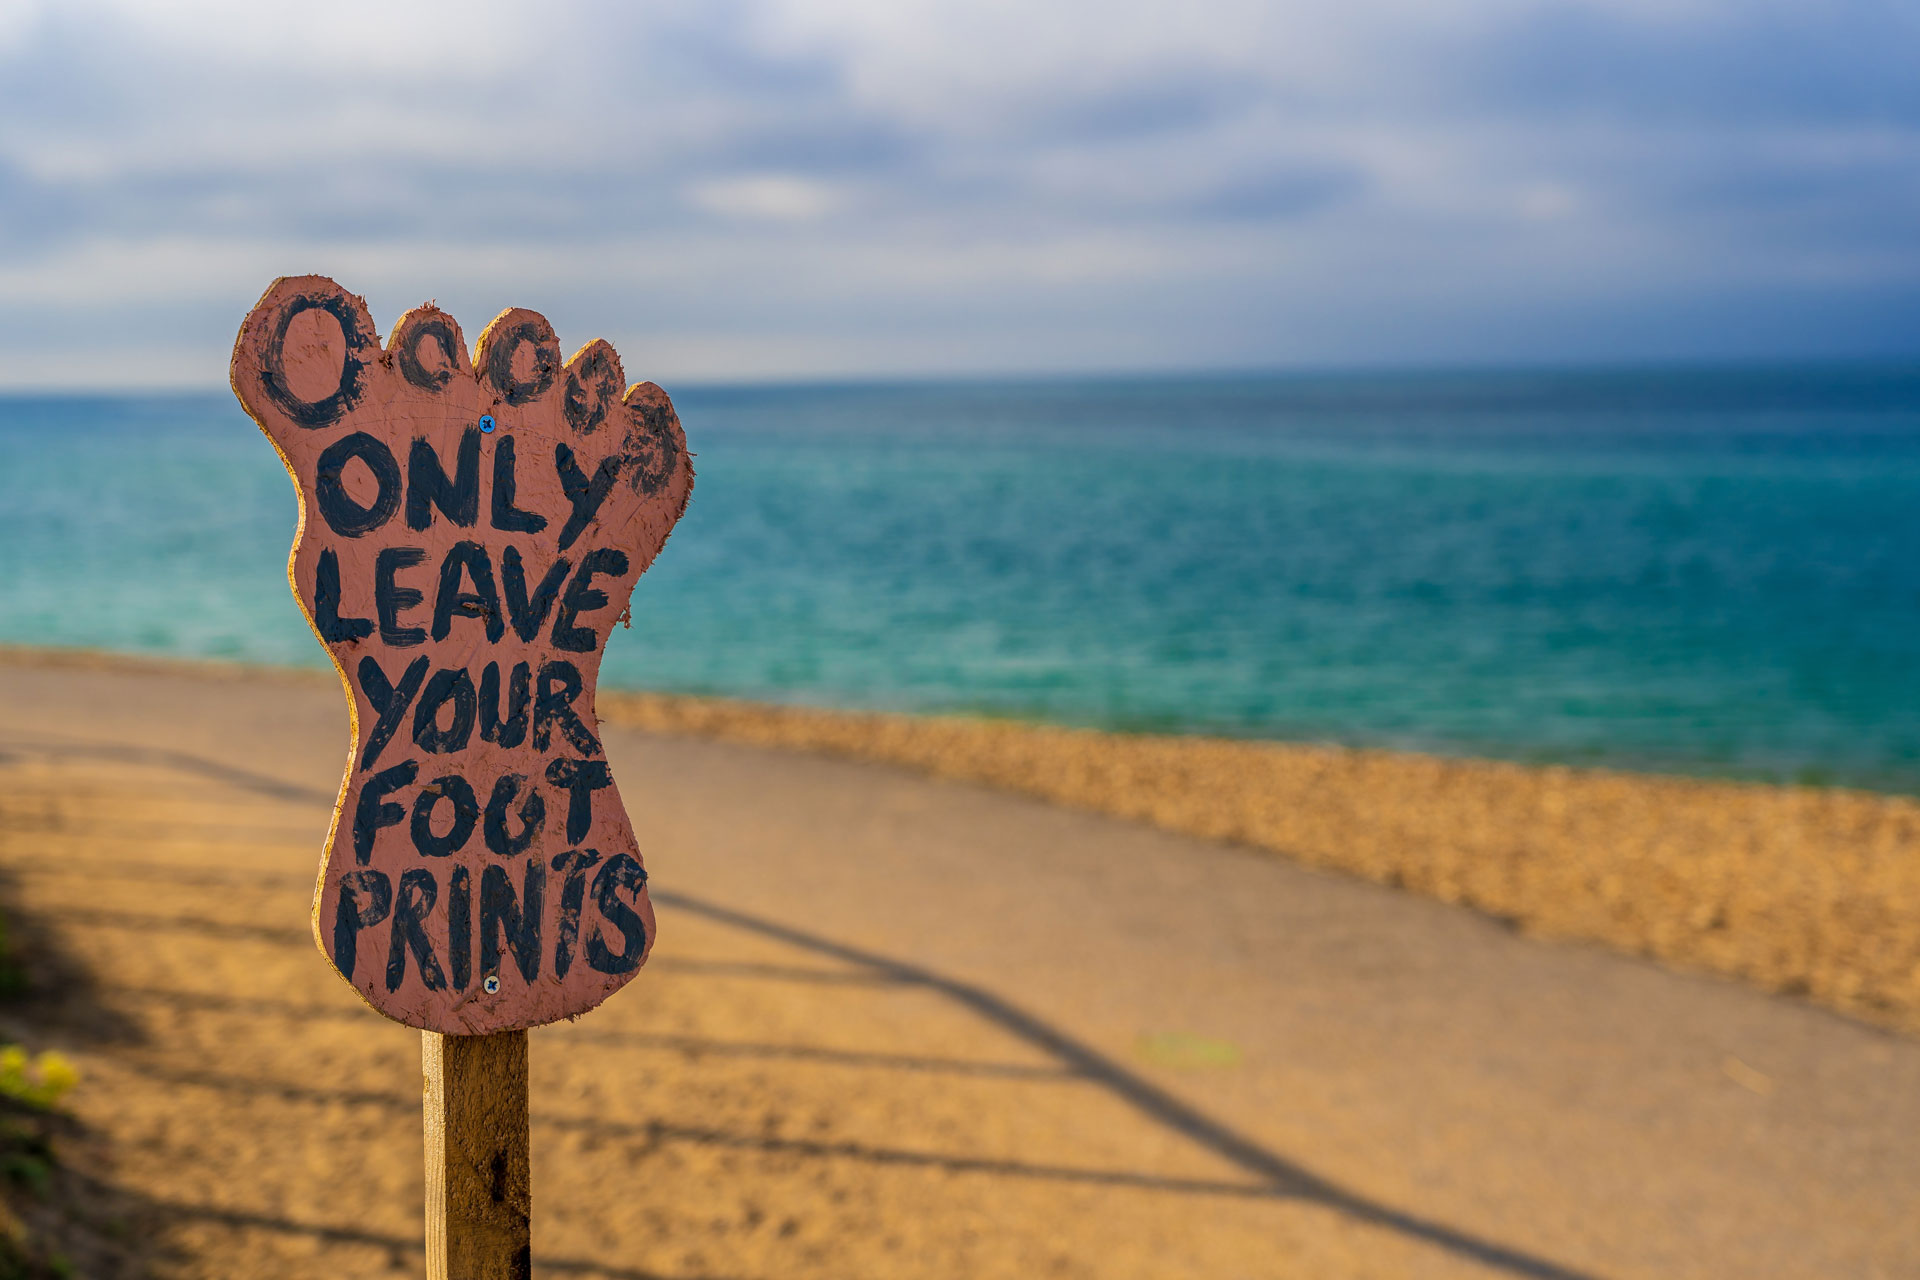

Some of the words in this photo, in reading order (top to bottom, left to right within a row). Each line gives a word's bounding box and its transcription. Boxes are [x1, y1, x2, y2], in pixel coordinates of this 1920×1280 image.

[315, 424, 620, 552] ONLY
[314, 541, 629, 651] LEAVE
[358, 655, 603, 770] YOUR
[354, 759, 613, 866] FOOT
[334, 848, 649, 992] PRINTS
